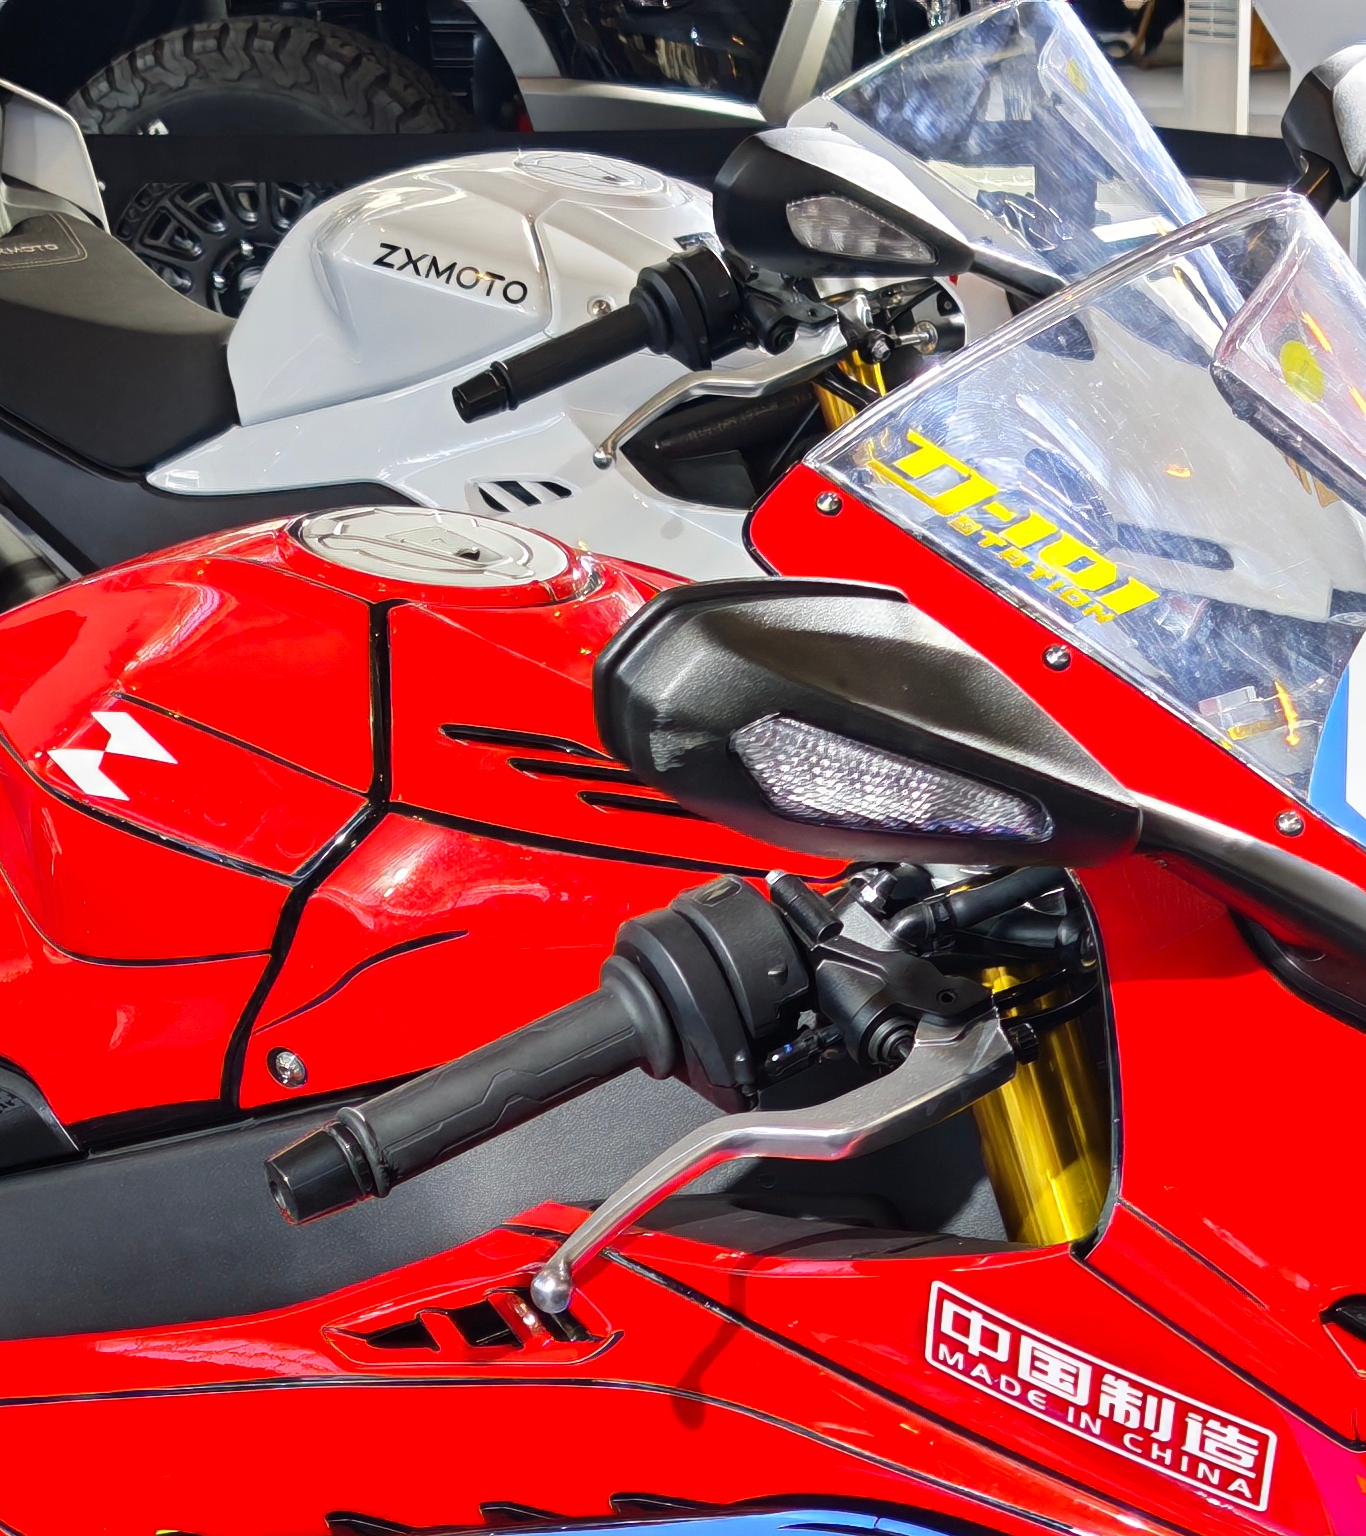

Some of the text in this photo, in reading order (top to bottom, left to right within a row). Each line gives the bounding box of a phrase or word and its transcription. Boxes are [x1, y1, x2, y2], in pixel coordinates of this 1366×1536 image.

[372, 243, 528, 305] ZXMOTO
[947, 514, 1116, 625] STATION
[937, 1343, 1253, 1500] MADE IN CHINA
[940, 1299, 1260, 1479] 中国制造
